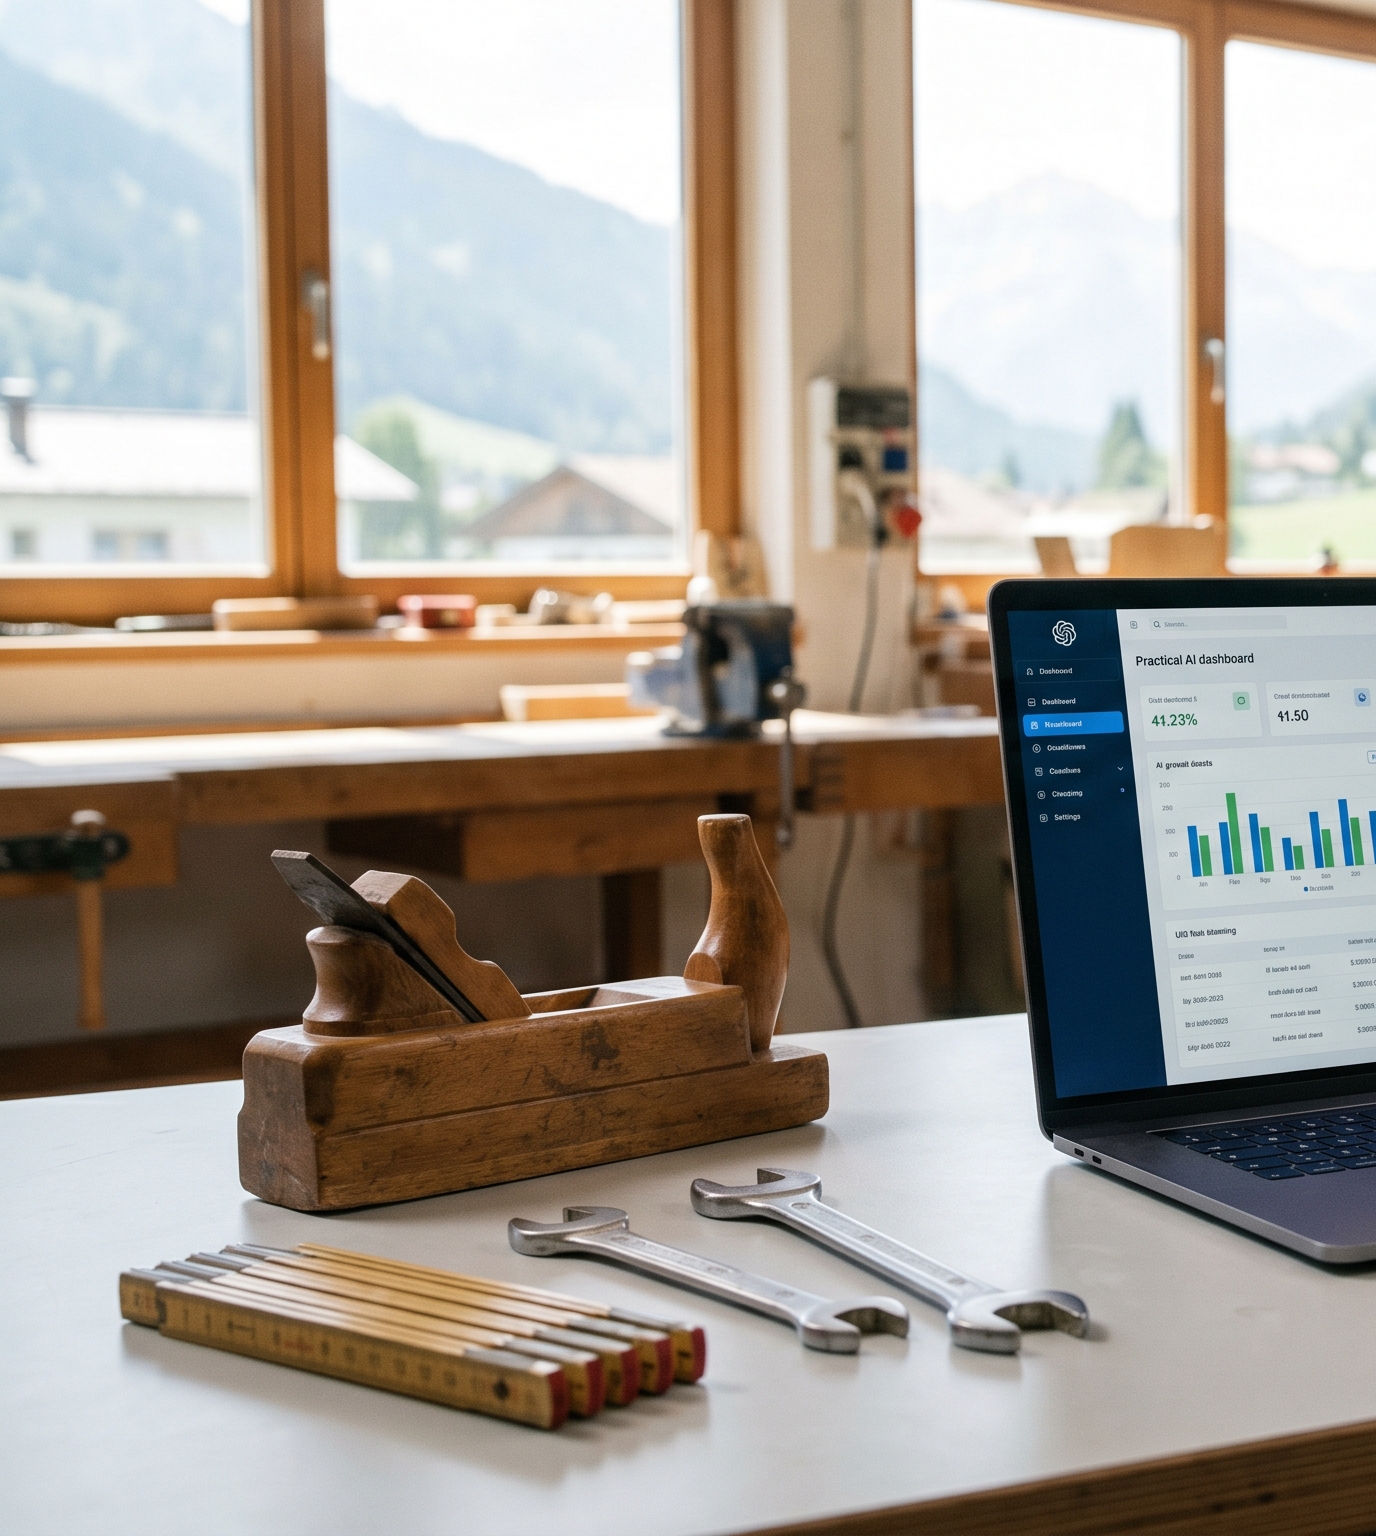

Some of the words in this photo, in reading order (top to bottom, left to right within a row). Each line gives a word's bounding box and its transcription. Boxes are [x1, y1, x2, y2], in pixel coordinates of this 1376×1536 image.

[1136, 655, 1182, 666] Practical
[1186, 655, 1196, 664] AI
[1199, 653, 1254, 664] dashboard
[1152, 714, 1197, 726] 41.23%
[1278, 710, 1308, 722] 41.50
